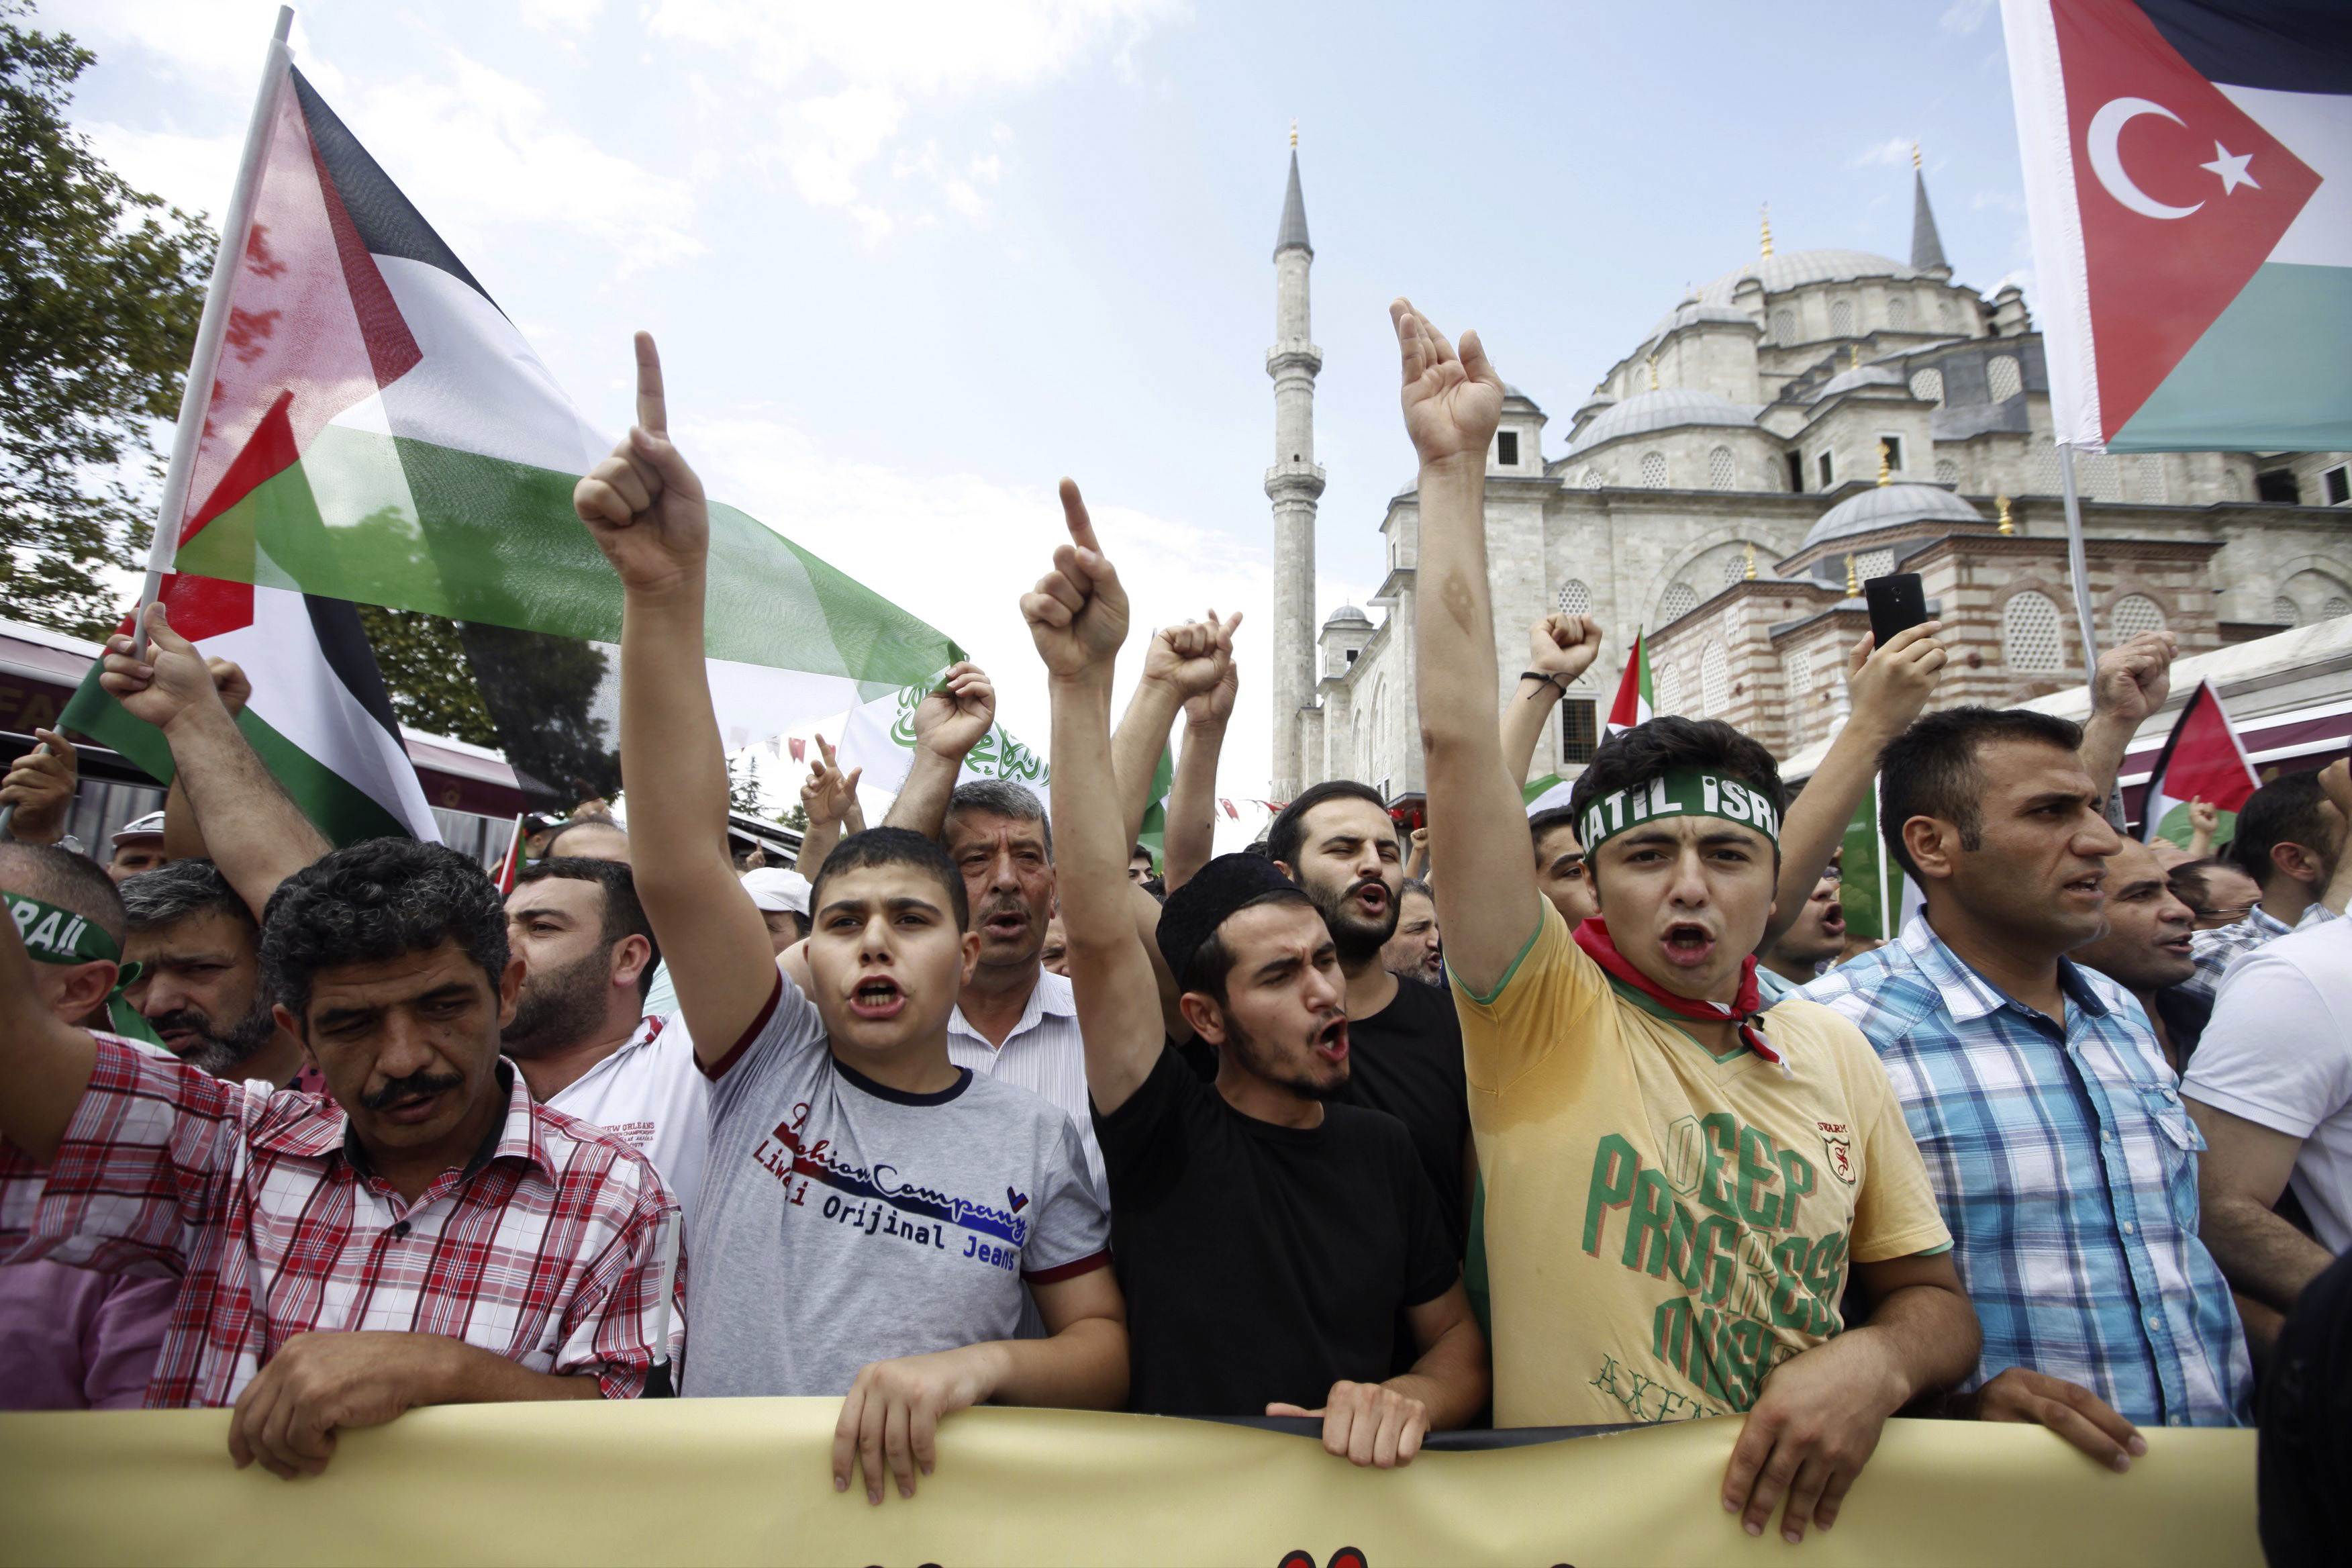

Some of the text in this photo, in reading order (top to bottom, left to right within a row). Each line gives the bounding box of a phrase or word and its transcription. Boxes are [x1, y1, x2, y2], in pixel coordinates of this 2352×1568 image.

[622, 1122, 655, 1131] ORLEANS
[1816, 1122, 1849, 1134] SWARM
[874, 1164, 1027, 1239] Company
[1665, 1112, 1818, 1234] DEEP
[823, 1195, 945, 1249] Orijinal
[963, 1235, 1015, 1271] Jeans
